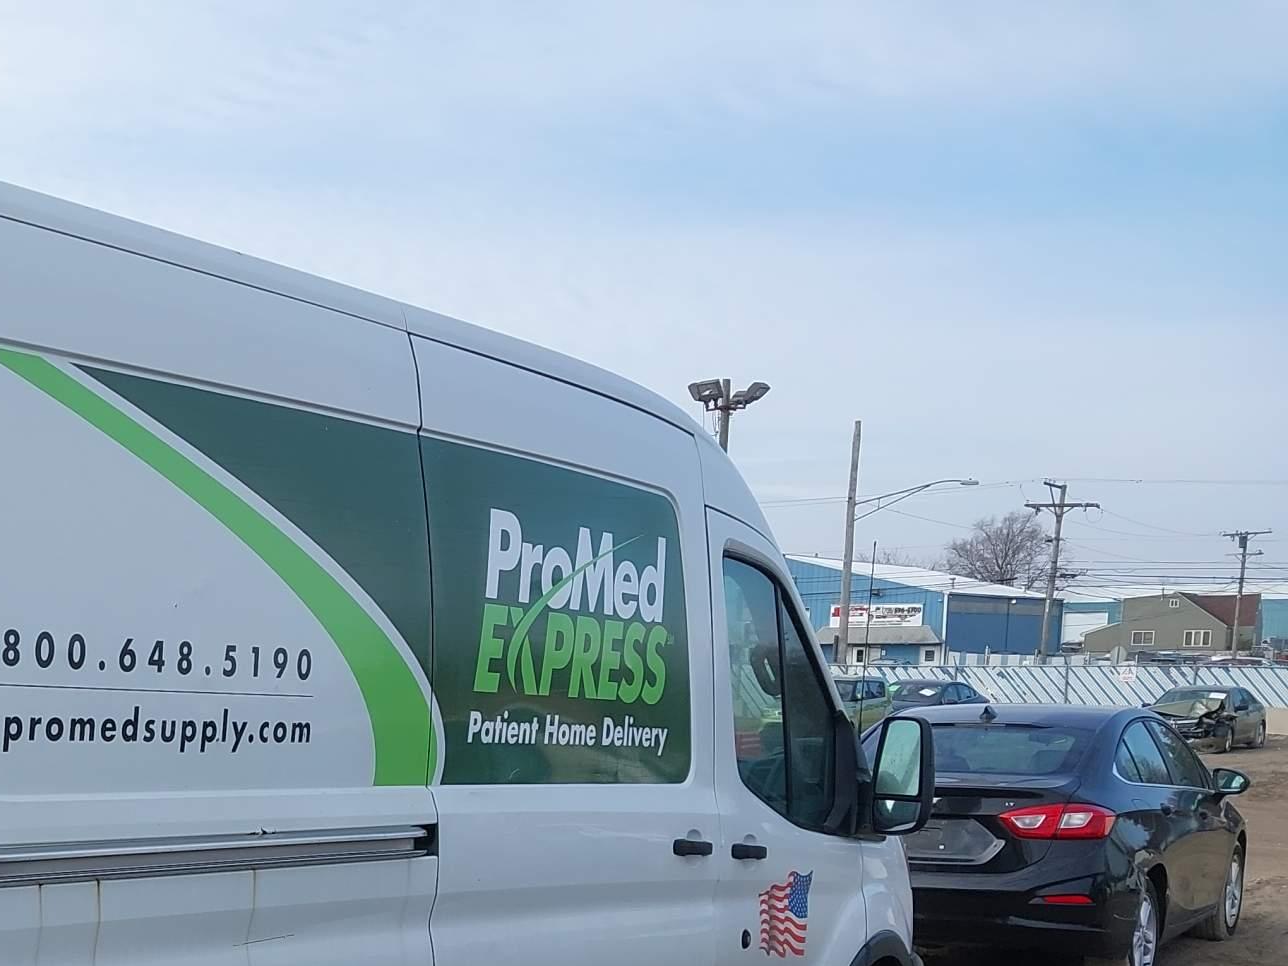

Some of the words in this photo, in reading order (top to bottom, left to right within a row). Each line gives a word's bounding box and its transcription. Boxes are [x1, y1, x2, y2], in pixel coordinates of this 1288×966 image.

[485, 508, 667, 623] ProMed
[2, 629, 312, 680] 800.648.5190
[473, 603, 669, 704] EXPRESS
[3, 706, 311, 752] promedsupply.com
[467, 710, 539, 745] Patient
[543, 714, 597, 746] Home
[601, 717, 668, 756] Delivery
